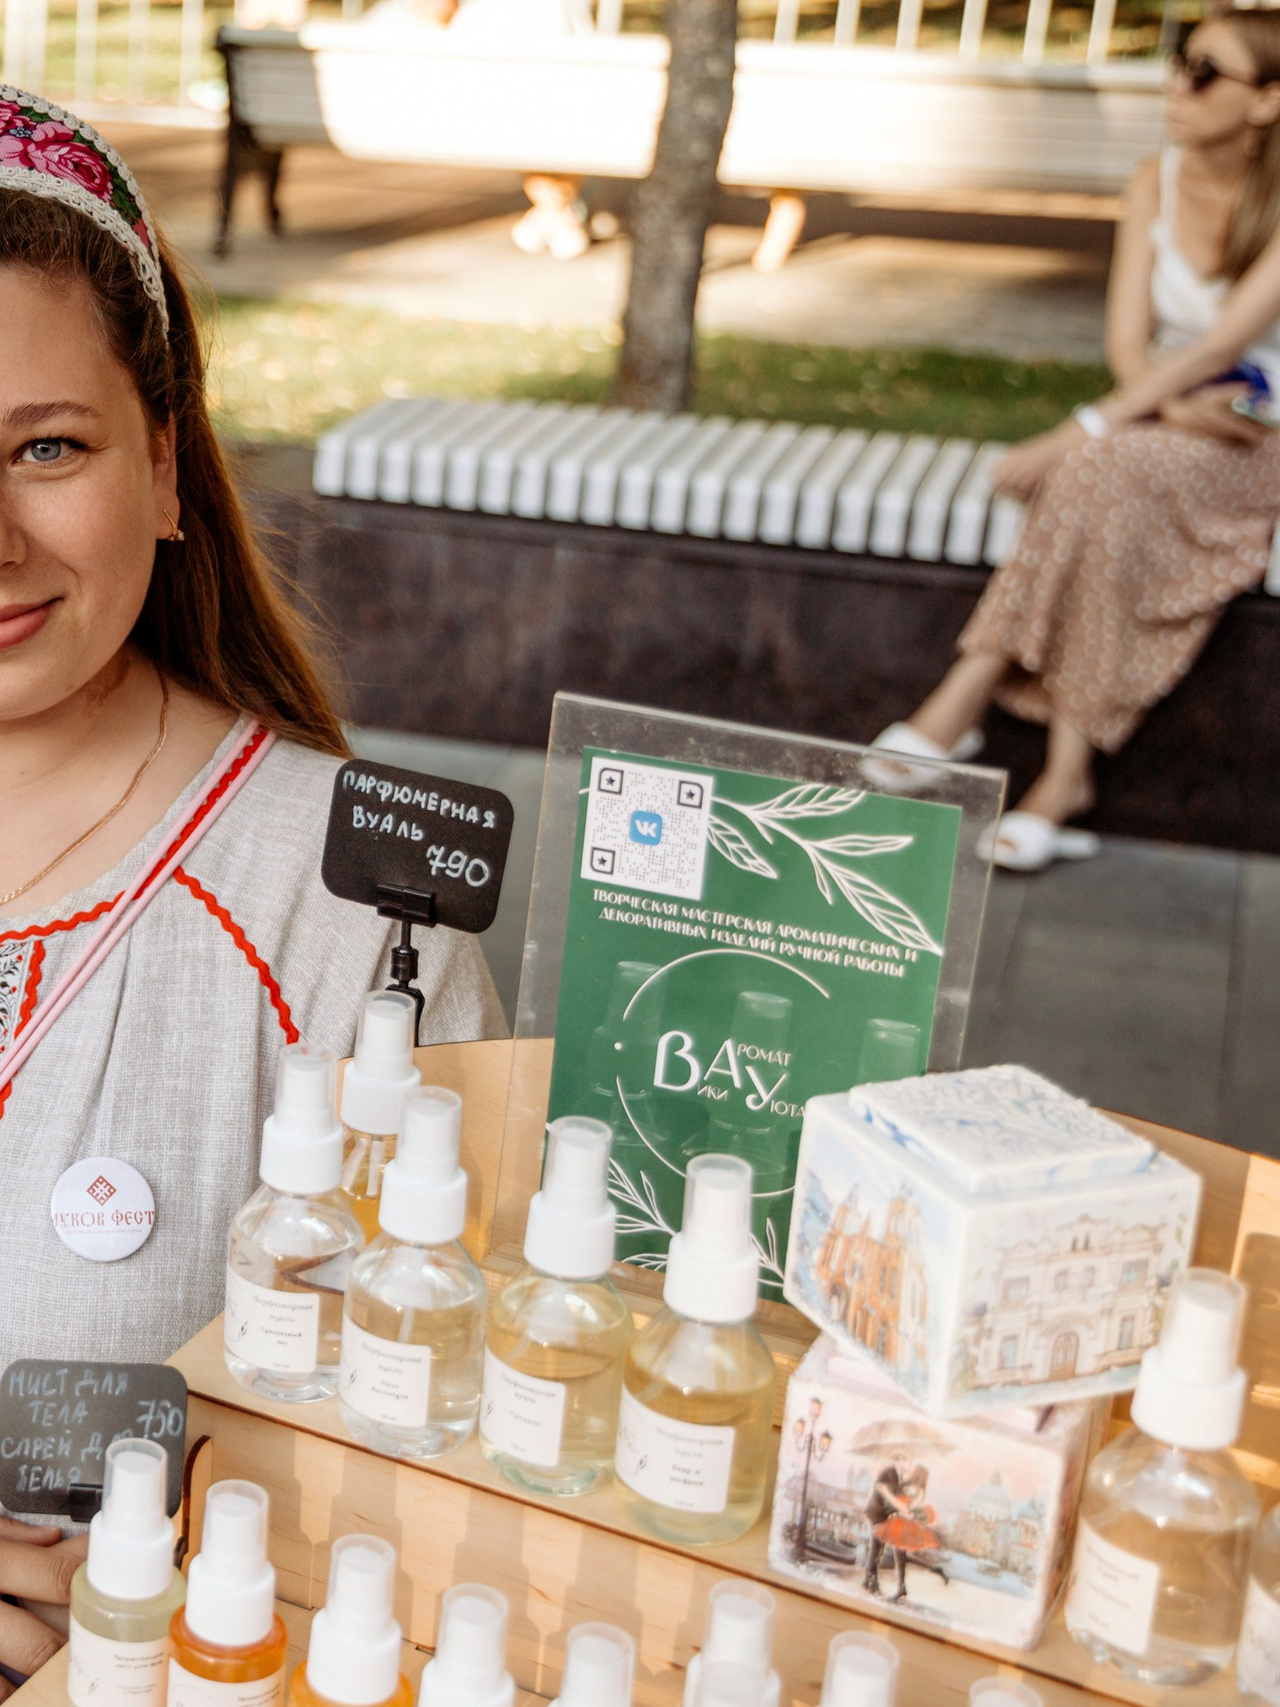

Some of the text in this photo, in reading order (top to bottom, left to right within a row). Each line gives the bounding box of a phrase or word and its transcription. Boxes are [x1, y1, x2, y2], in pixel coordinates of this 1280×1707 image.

[342, 770, 496, 829] ПАРФЮМЕРНАЯ
[352, 805, 424, 841] ВУАЛЬ
[426, 845, 490, 888] 790
[593, 888, 918, 963] ТВОРЧЕСКАЯ МАСТЕРСКАЯ АРОМАТИЧЕСКИХ И
[598, 906, 905, 978] ДЕКОРАТИВНЫХ ИЗДЕЛИЙ РУЧНОЙ РАБОТЫ
[111, 1210, 154, 1226] ФЕСТ
[8, 1368, 128, 1397] МИСТ ДЛЯ
[28, 1398, 184, 1440] ТЕЛА 750
[0, 1430, 73, 1460] СПРЕЙ
